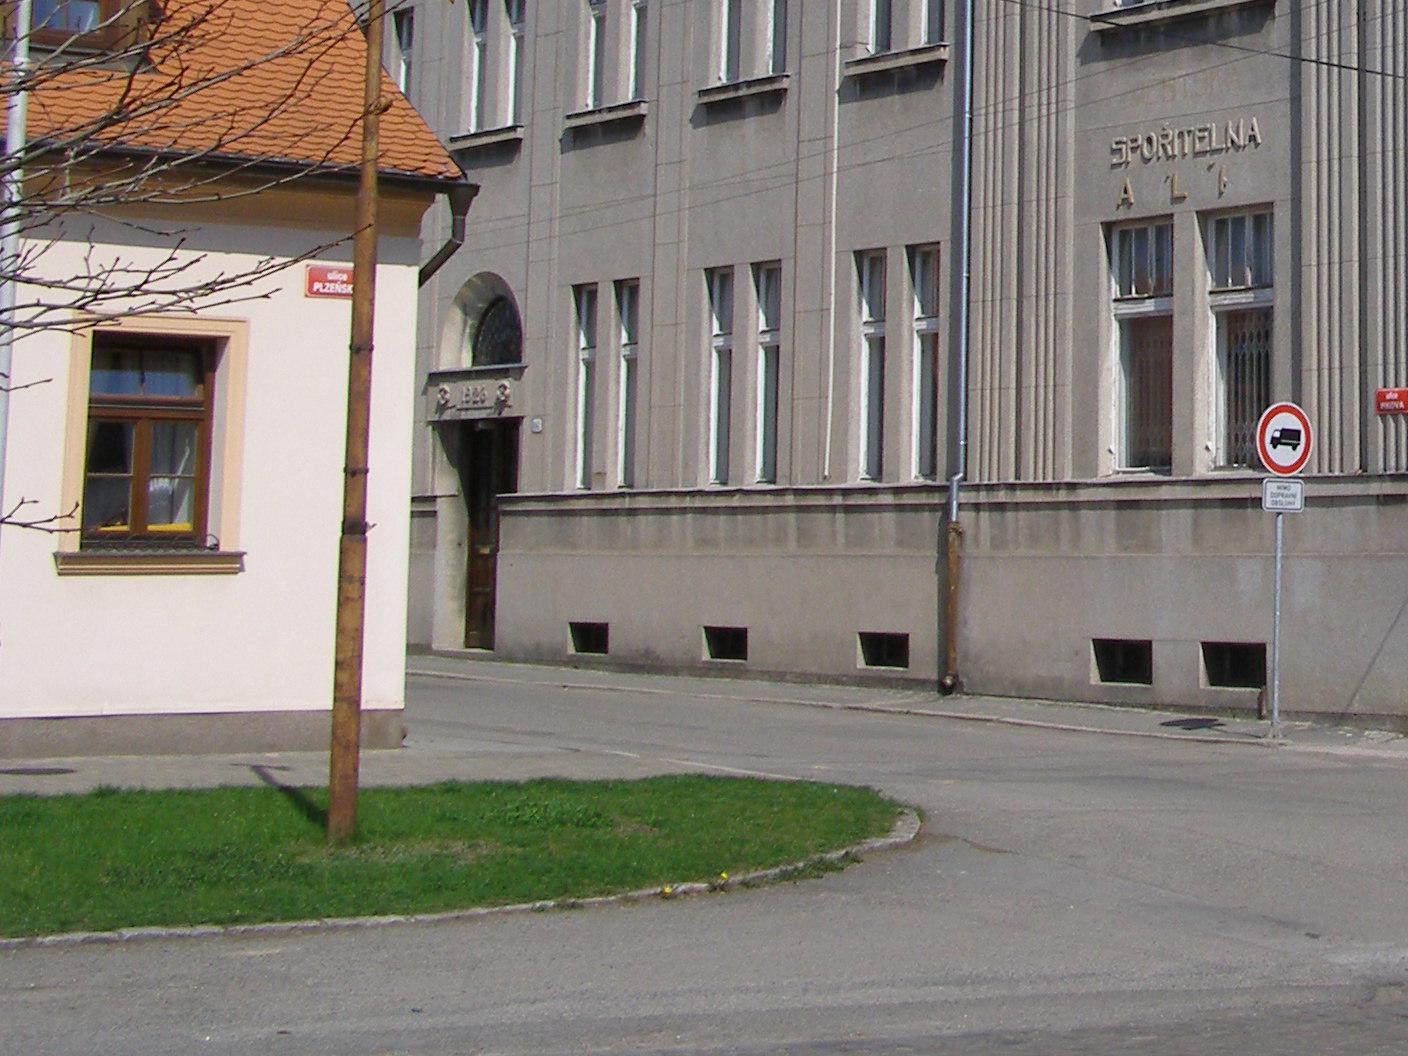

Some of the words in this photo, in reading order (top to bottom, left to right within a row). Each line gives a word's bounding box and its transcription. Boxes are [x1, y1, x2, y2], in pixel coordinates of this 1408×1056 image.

[1110, 117, 1262, 167] SPOŘITELNA
[327, 271, 348, 281] ulice
[313, 281, 354, 294] PLZEŇSK
